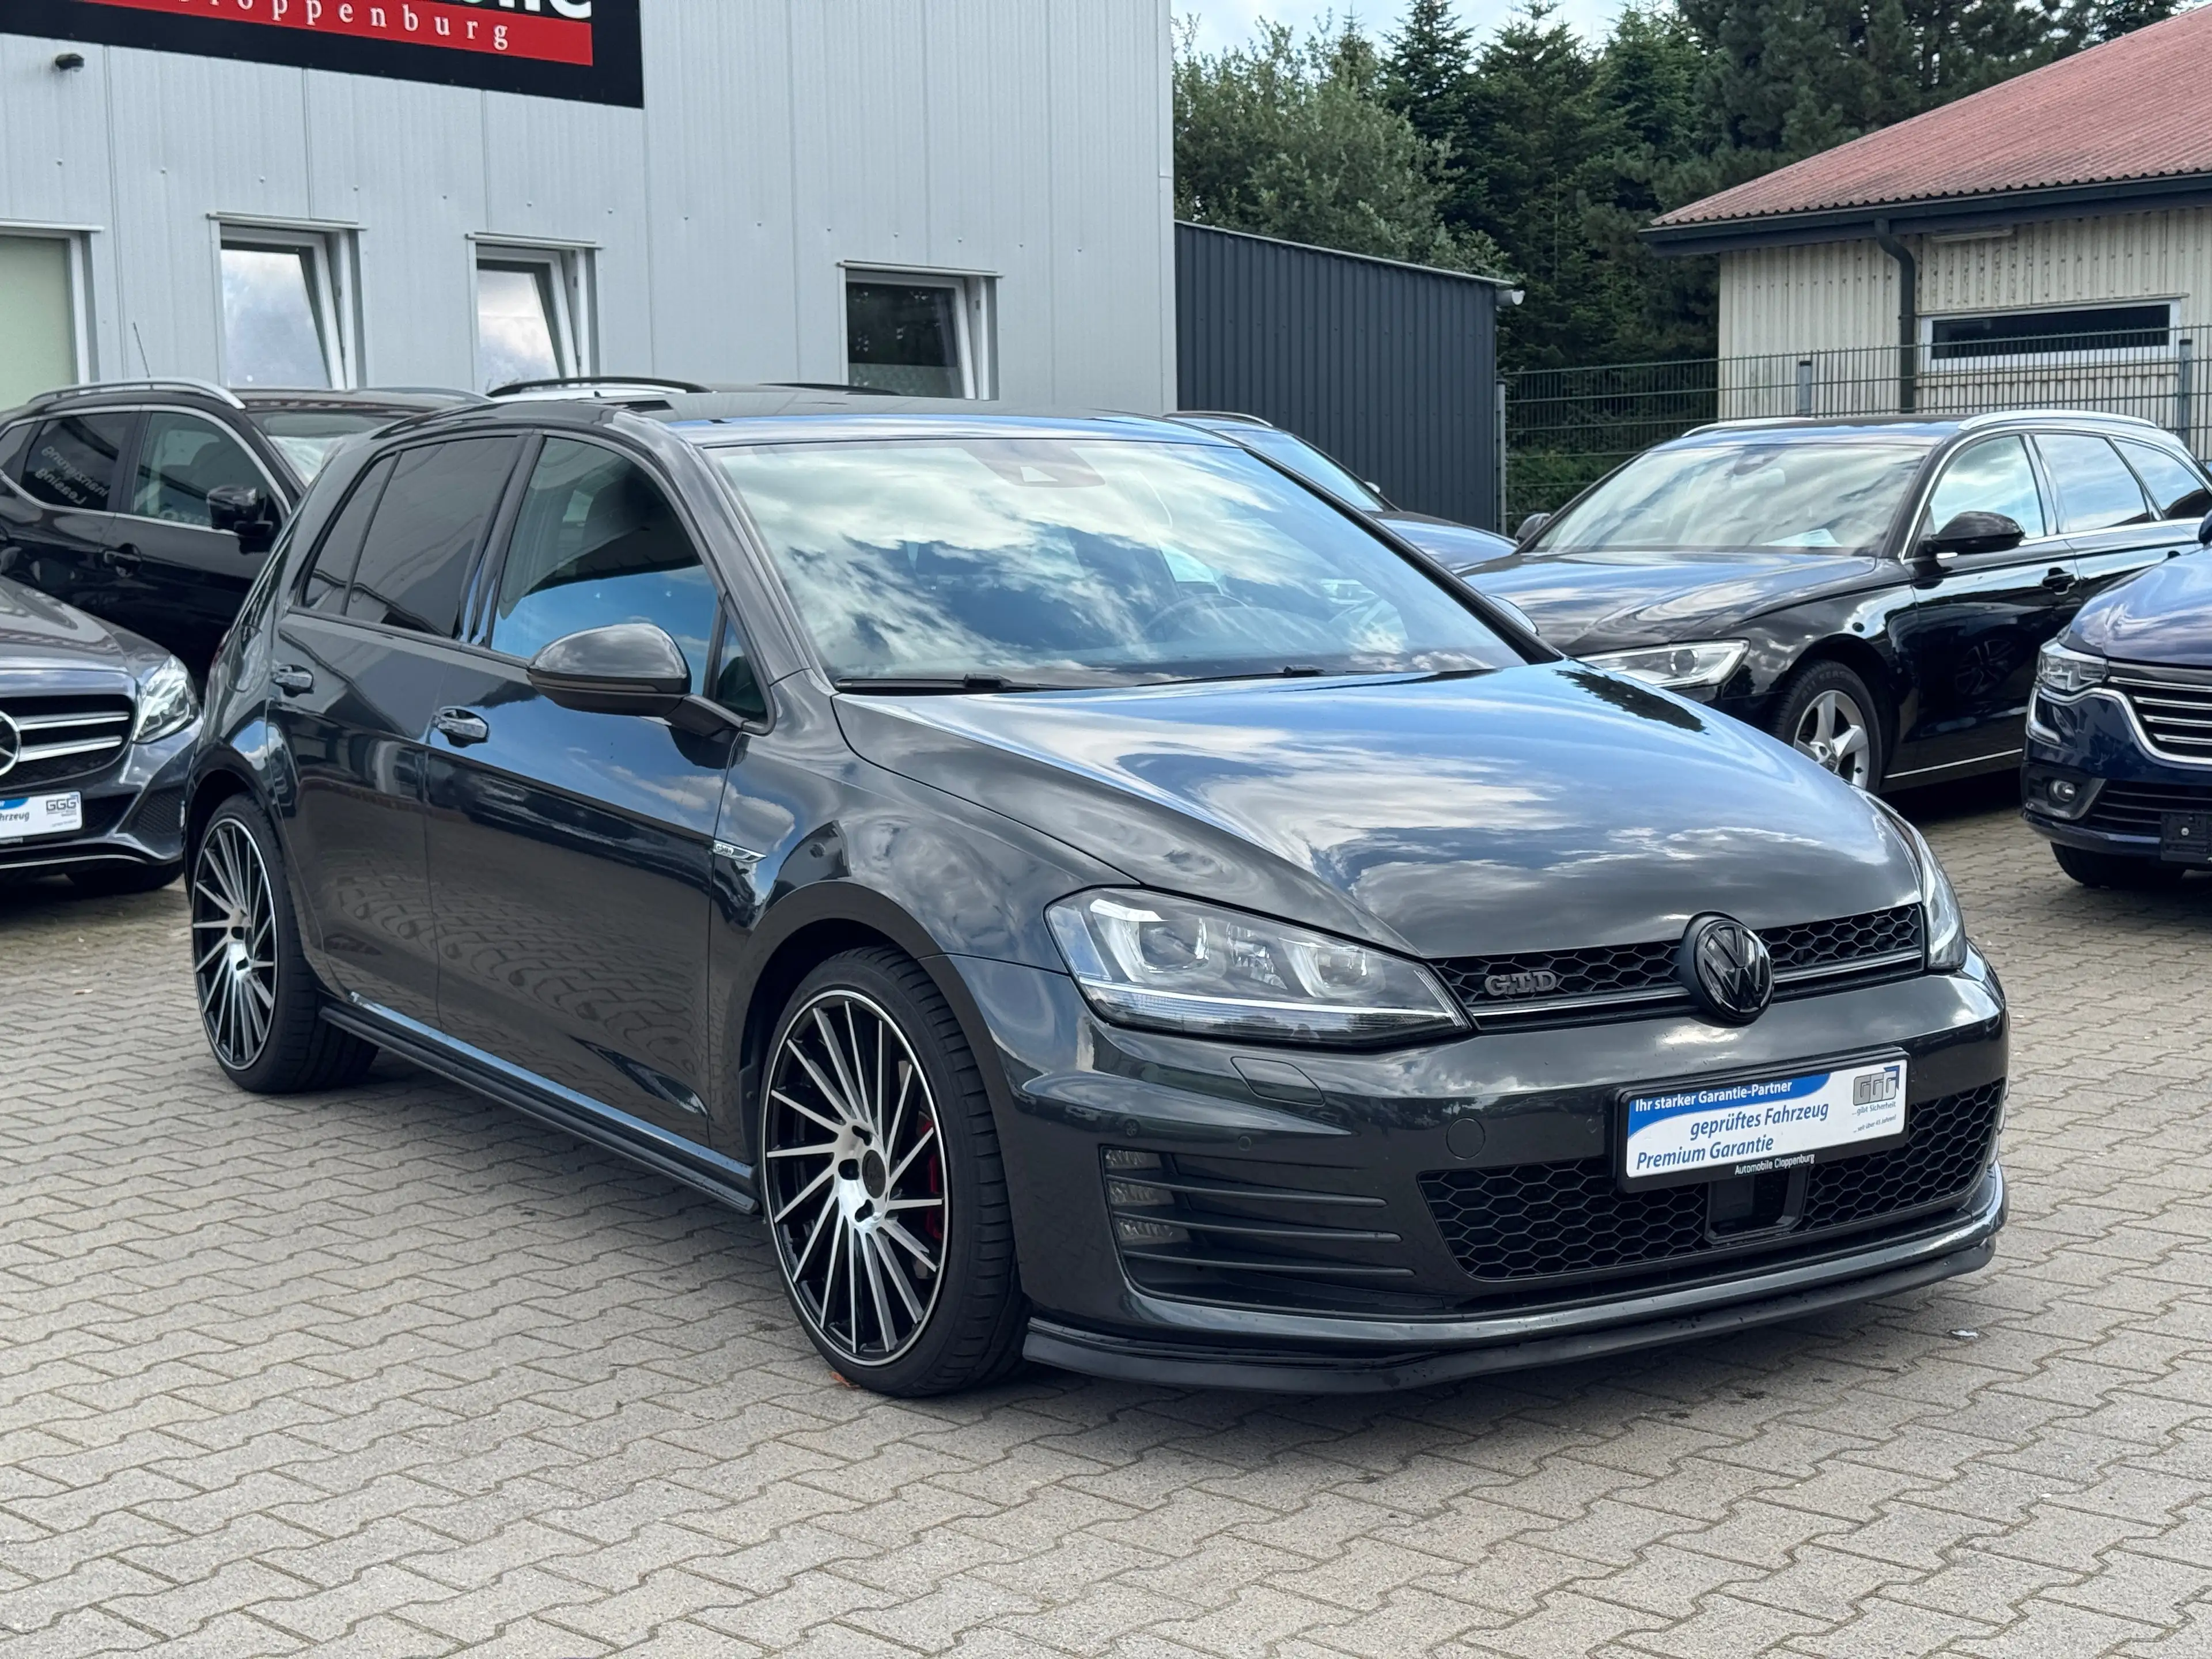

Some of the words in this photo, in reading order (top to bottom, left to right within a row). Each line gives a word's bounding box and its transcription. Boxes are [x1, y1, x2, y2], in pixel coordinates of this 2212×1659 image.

[177, 0, 508, 50] oppenburg
[46, 798, 77, 811] GGG
[1484, 970, 1556, 996] GTD
[1635, 1099, 1653, 1112] Ihr
[1654, 1093, 1696, 1110] starker
[1698, 1081, 1793, 1104] Garantie-Partner
[1869, 1101, 1896, 1112] Sicherheit
[1690, 1111, 1761, 1141] geprüftes
[1764, 1103, 1829, 1126] Fahrzeug
[1636, 1146, 1706, 1170] Premium
[1710, 1134, 1774, 1160] Garantie
[1734, 1159, 1773, 1175] Automobile
[1774, 1153, 1815, 1169] Cloppenburg
